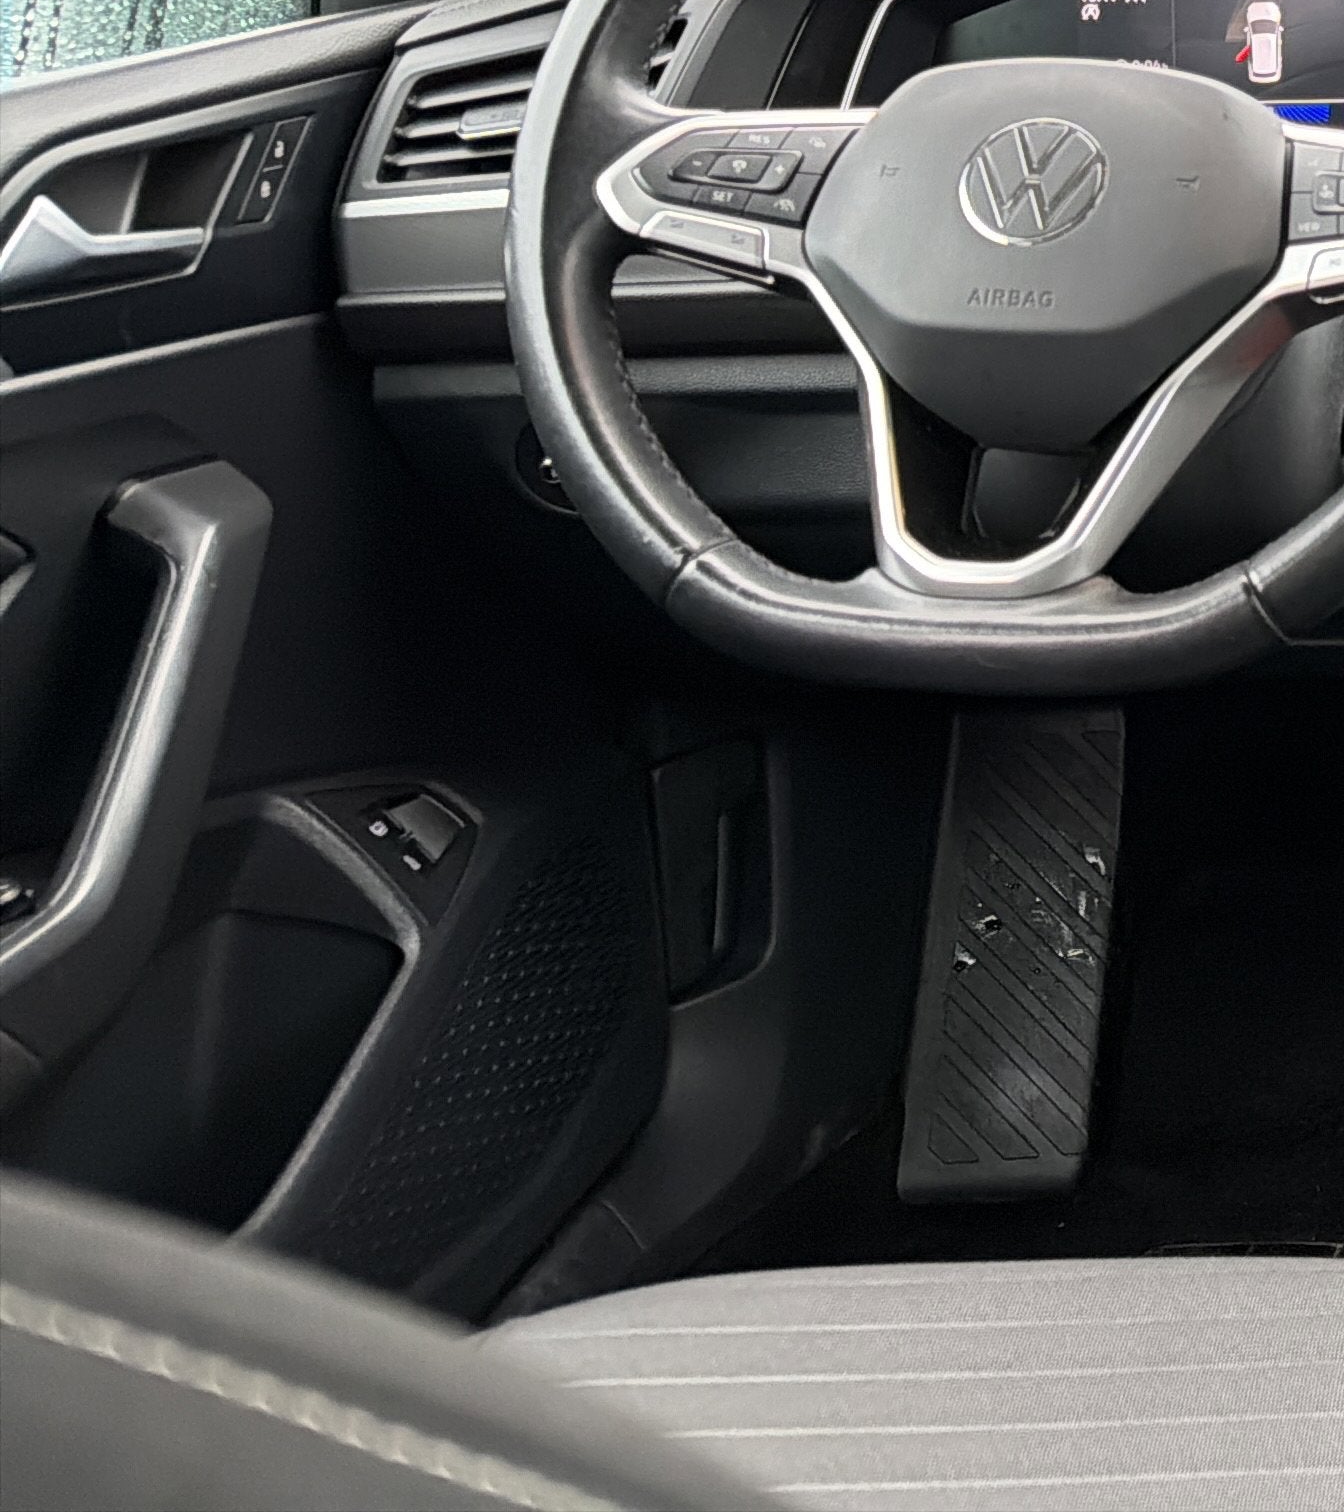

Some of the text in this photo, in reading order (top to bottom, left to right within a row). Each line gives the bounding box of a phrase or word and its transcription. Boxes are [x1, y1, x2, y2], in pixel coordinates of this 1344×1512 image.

[748, 133, 771, 146] RES
[711, 189, 735, 202] SET
[966, 287, 1056, 309] AIRBAG
